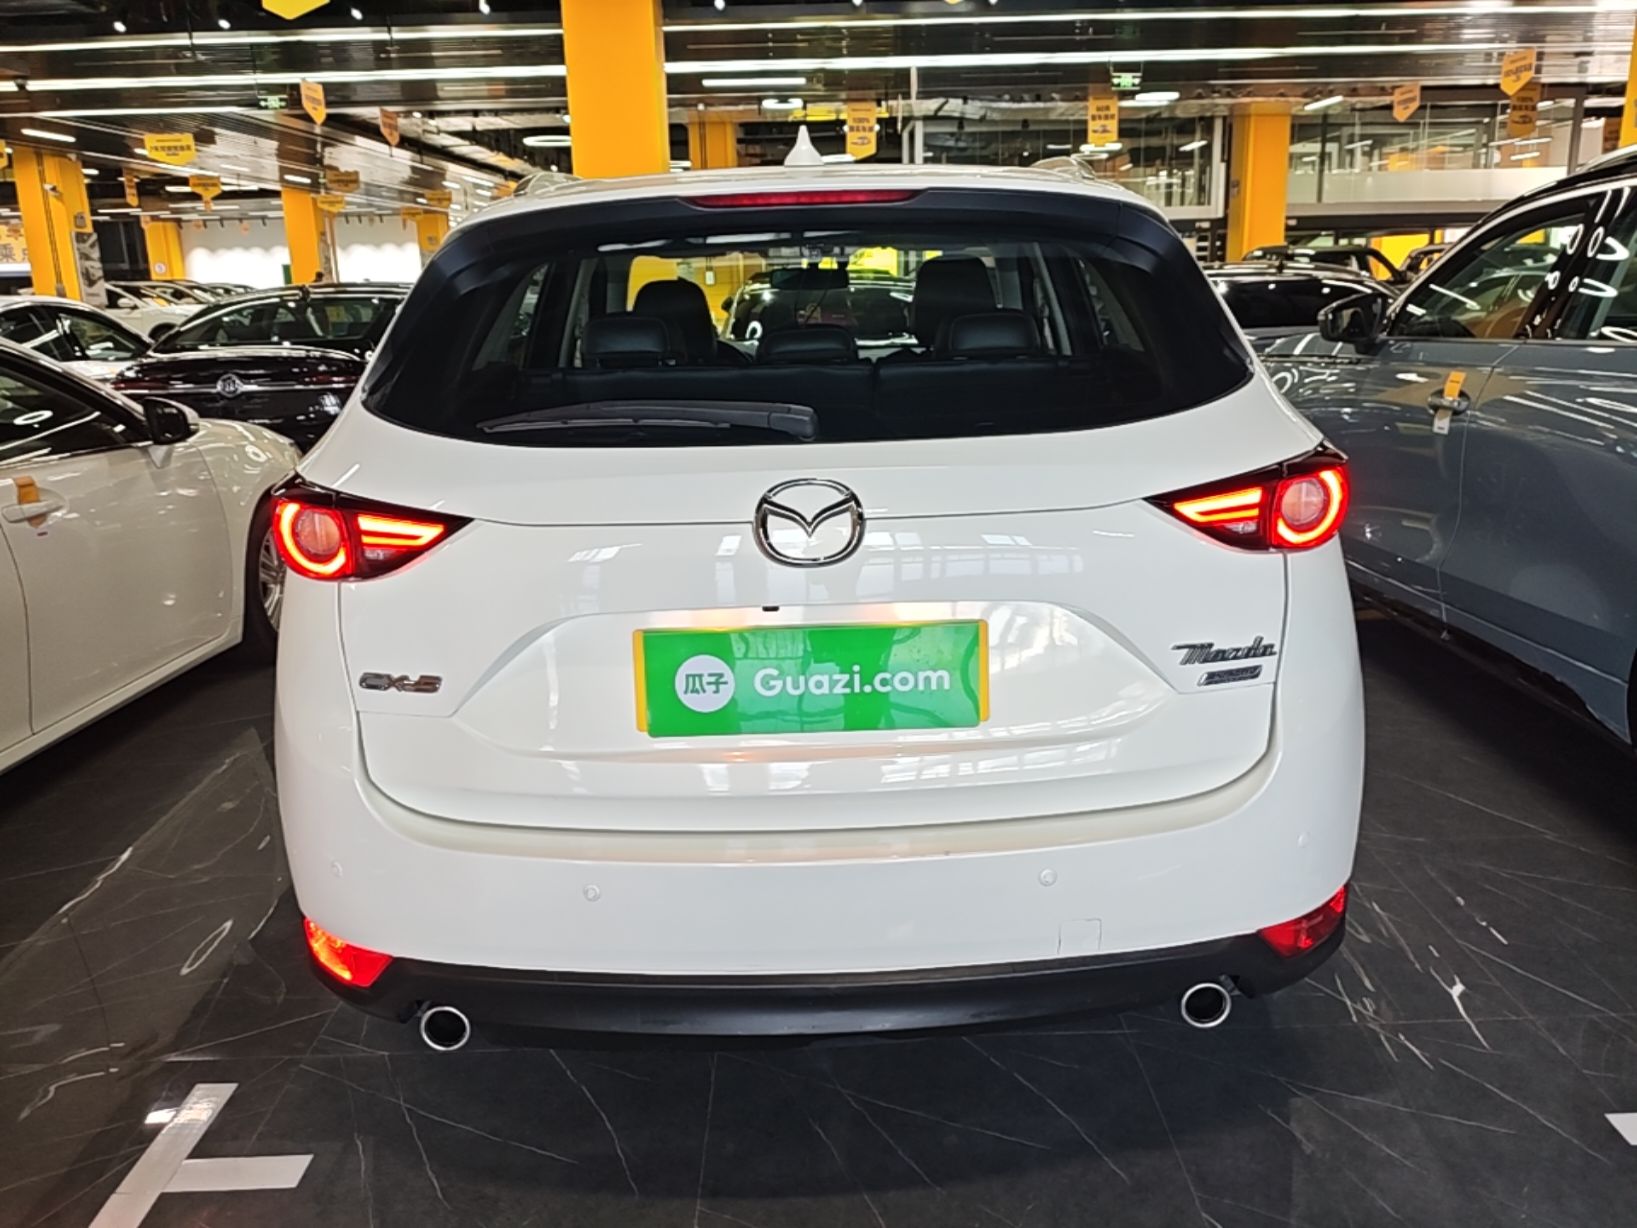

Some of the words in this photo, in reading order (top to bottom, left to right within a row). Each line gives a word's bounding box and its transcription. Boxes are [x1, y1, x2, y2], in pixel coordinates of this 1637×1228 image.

[358, 672, 443, 694] CX-5
[683, 671, 729, 695] 瓜子
[753, 665, 951, 697] Guazi.com
